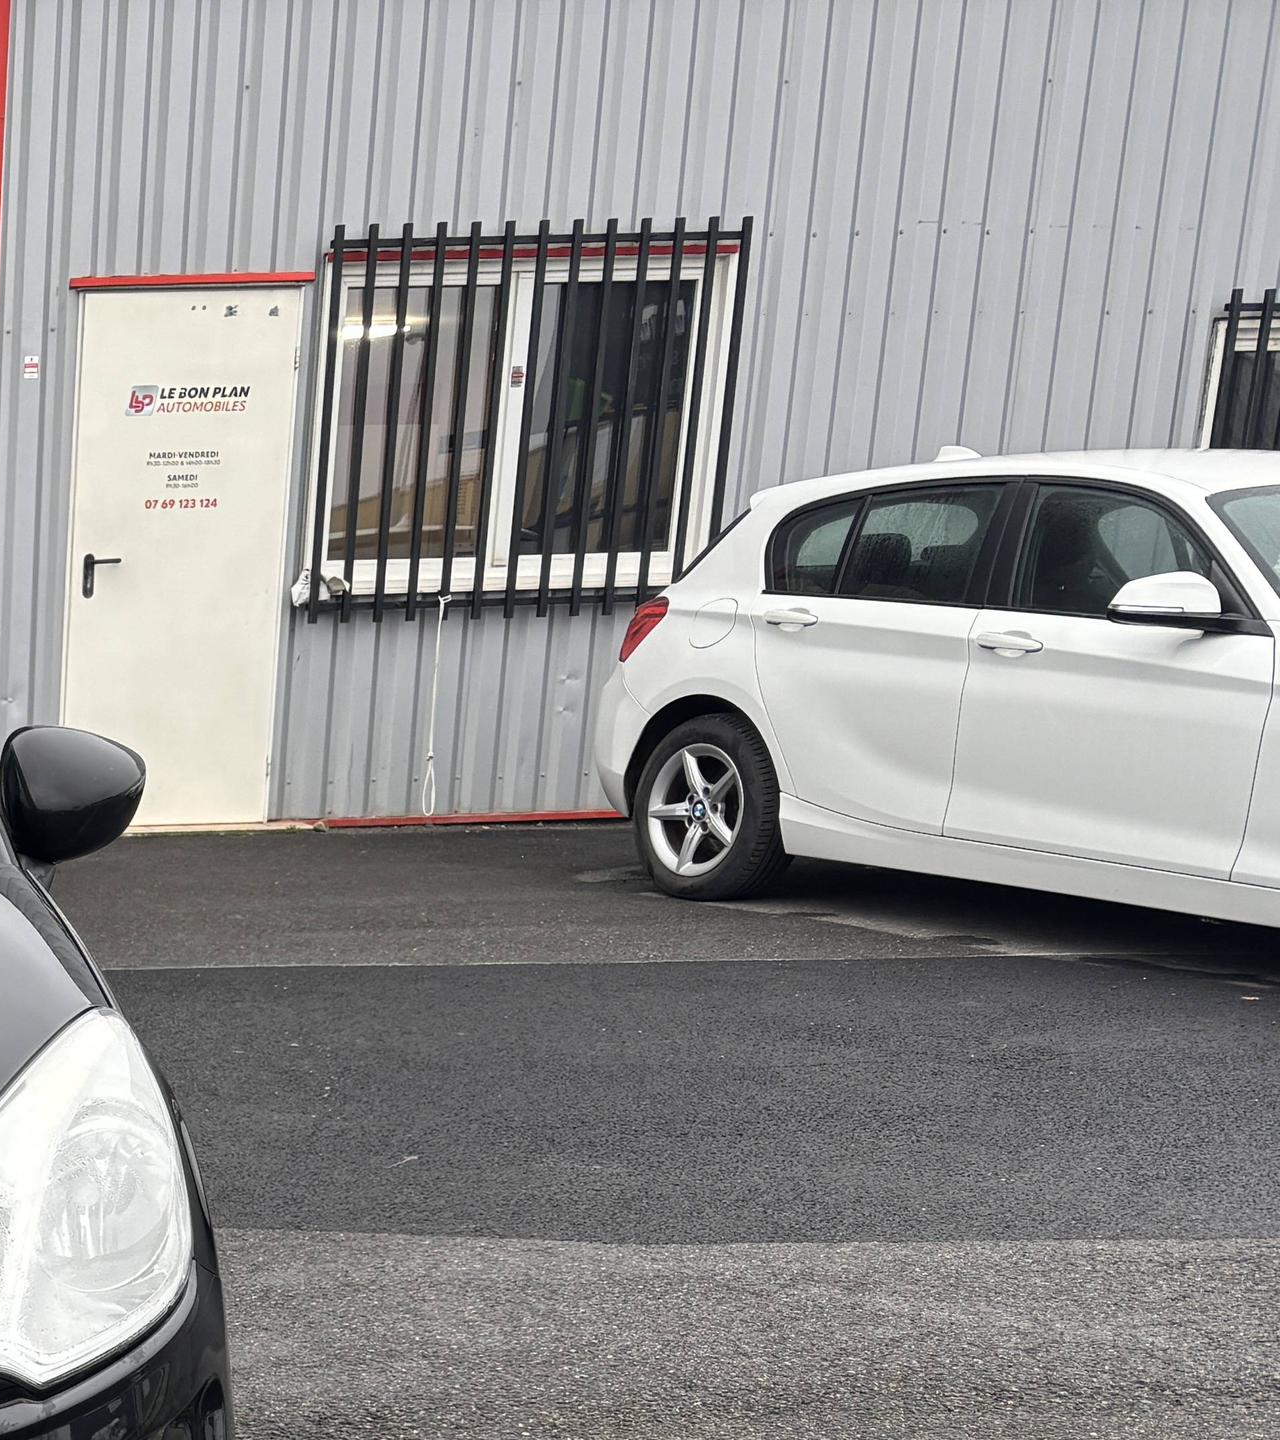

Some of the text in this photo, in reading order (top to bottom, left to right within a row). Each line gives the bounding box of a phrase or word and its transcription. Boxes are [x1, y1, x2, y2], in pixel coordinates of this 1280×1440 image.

[160, 386, 250, 399] LE BON PLAN
[156, 400, 247, 413] AUTOMOBILES
[144, 498, 217, 509] 07 69 123 124
